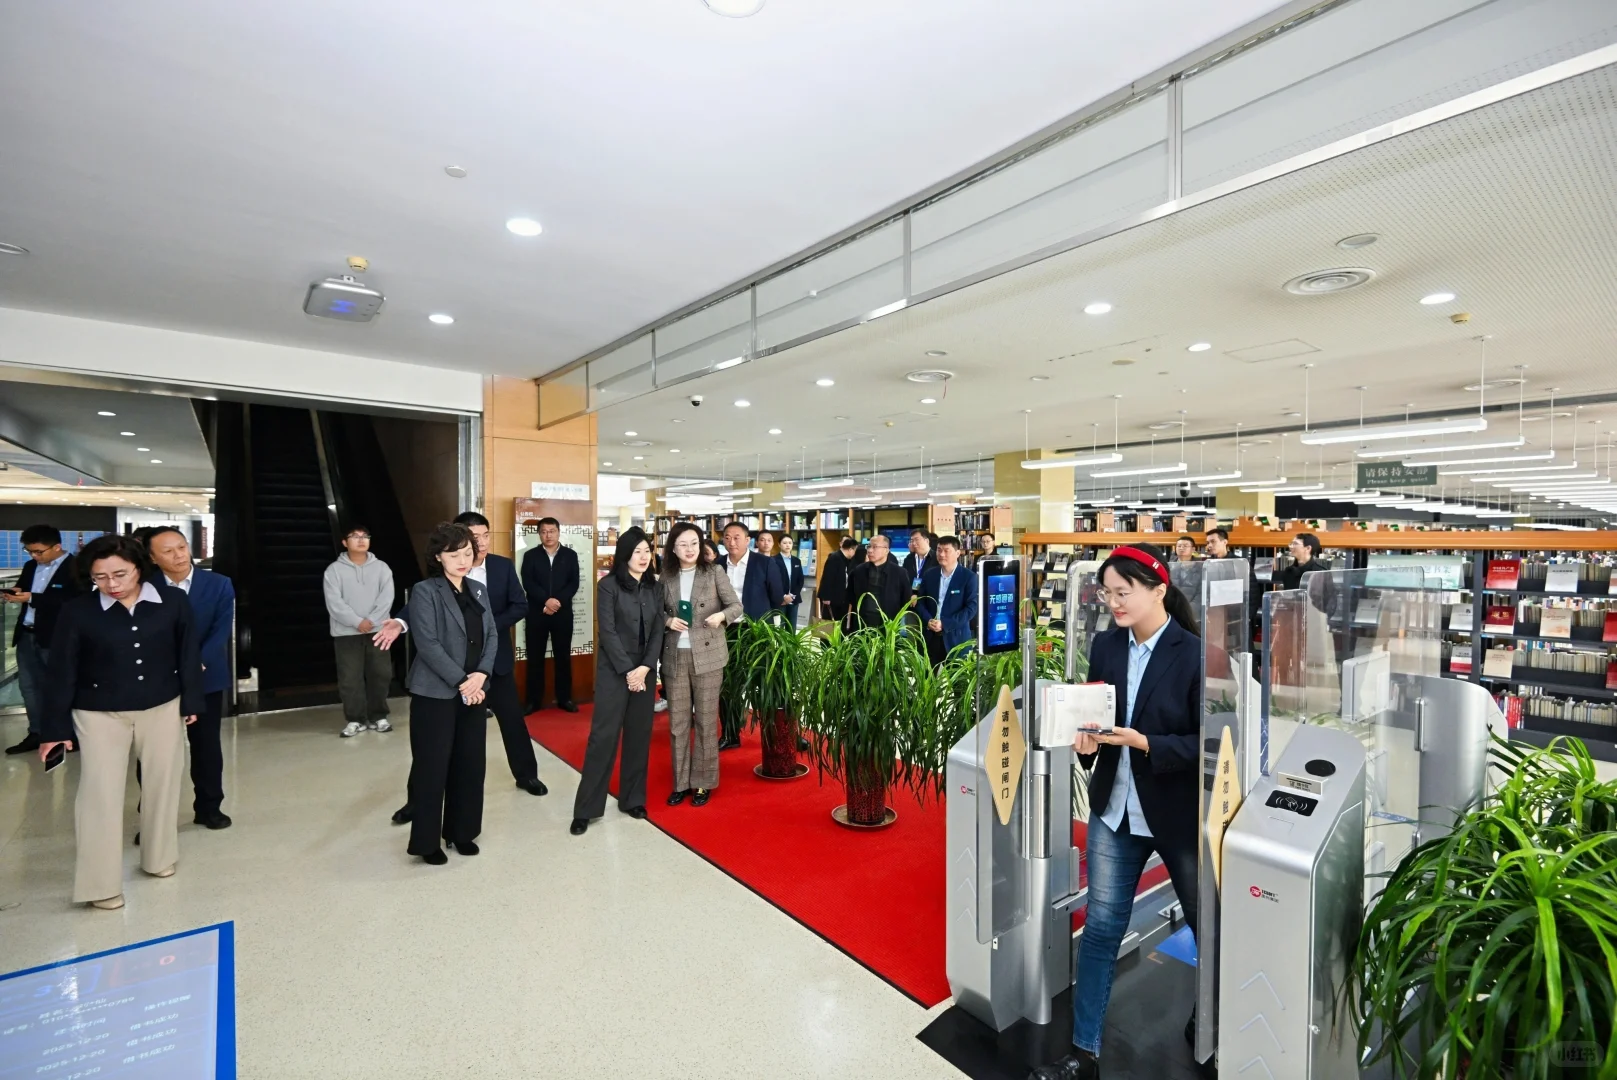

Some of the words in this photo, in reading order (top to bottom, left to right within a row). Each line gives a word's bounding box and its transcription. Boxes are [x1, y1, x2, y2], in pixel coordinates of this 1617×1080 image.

[1365, 466, 1429, 478] 请保持安静
[989, 593, 1014, 605] 无感通道
[1001, 710, 1010, 799] 请勿触碰闸门
[35, 1048, 106, 1074] 2025-12-20
